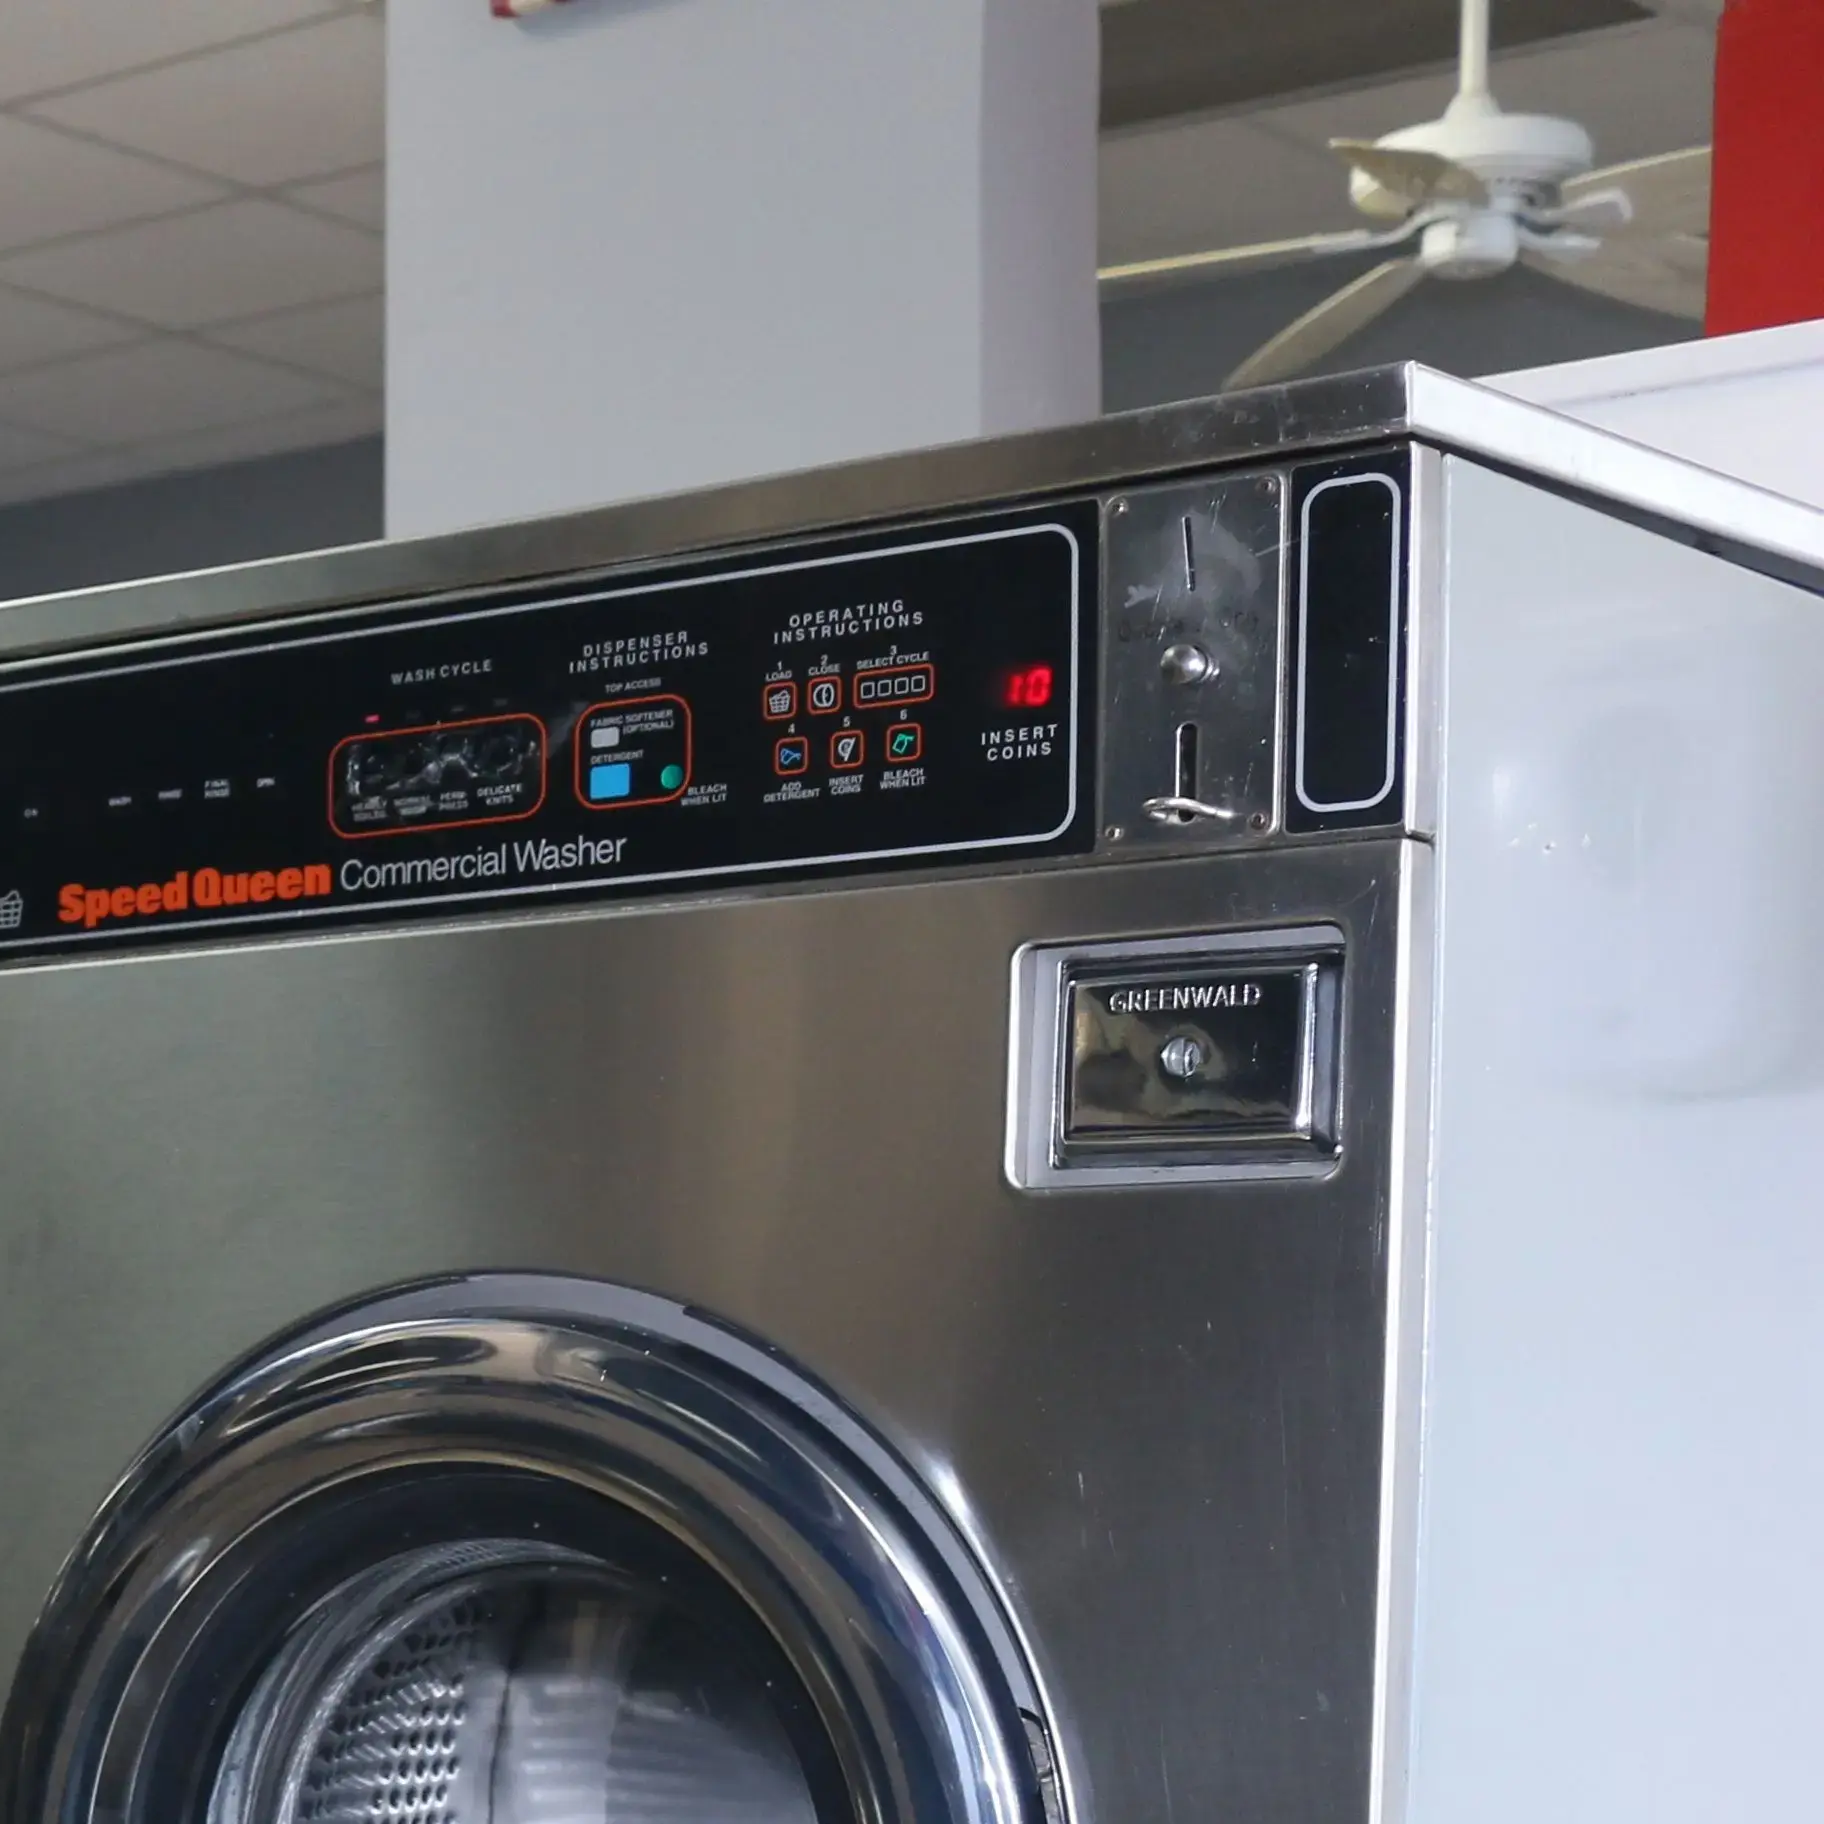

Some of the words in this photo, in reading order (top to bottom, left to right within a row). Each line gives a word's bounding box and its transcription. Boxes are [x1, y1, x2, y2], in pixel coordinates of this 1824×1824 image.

[789, 599, 904, 628] OPERATING
[773, 612, 923, 645] INSTRUCTIONS
[583, 631, 688, 658] DISPENSER
[890, 645, 897, 655] 3
[569, 642, 708, 674] INSTRUCTIONS
[820, 654, 828, 667] 2
[856, 655, 894, 670] SELECT
[896, 651, 930, 665] CYCLE
[391, 665, 435, 685] WASH
[440, 659, 492, 679] CYCLE
[777, 661, 783, 672] 1
[808, 663, 841, 677] CLOSE
[765, 670, 792, 682] LOAD
[605, 682, 623, 693] TOP
[624, 677, 661, 691] ACCESS
[590, 714, 623, 728] FABRIC
[625, 709, 673, 723] SOFTENER
[788, 723, 795, 734] 4
[981, 724, 1058, 745] INSERT
[590, 749, 644, 765] DETERGENT
[987, 742, 1052, 761] COINS
[828, 774, 864, 787] INSERT
[883, 768, 924, 780] BLEACH
[687, 784, 727, 796] BLEACH
[880, 778, 909, 790] WHEN
[911, 776, 926, 787] LIT
[680, 795, 710, 807] WHEN
[712, 792, 727, 803] LIT
[763, 788, 821, 803] DETERGENT
[58, 870, 188, 928] Speed
[193, 864, 331, 907] Queen
[340, 843, 507, 891] Commercial
[513, 835, 627, 873] Washer
[1109, 983, 1263, 1014] GREENWALD
